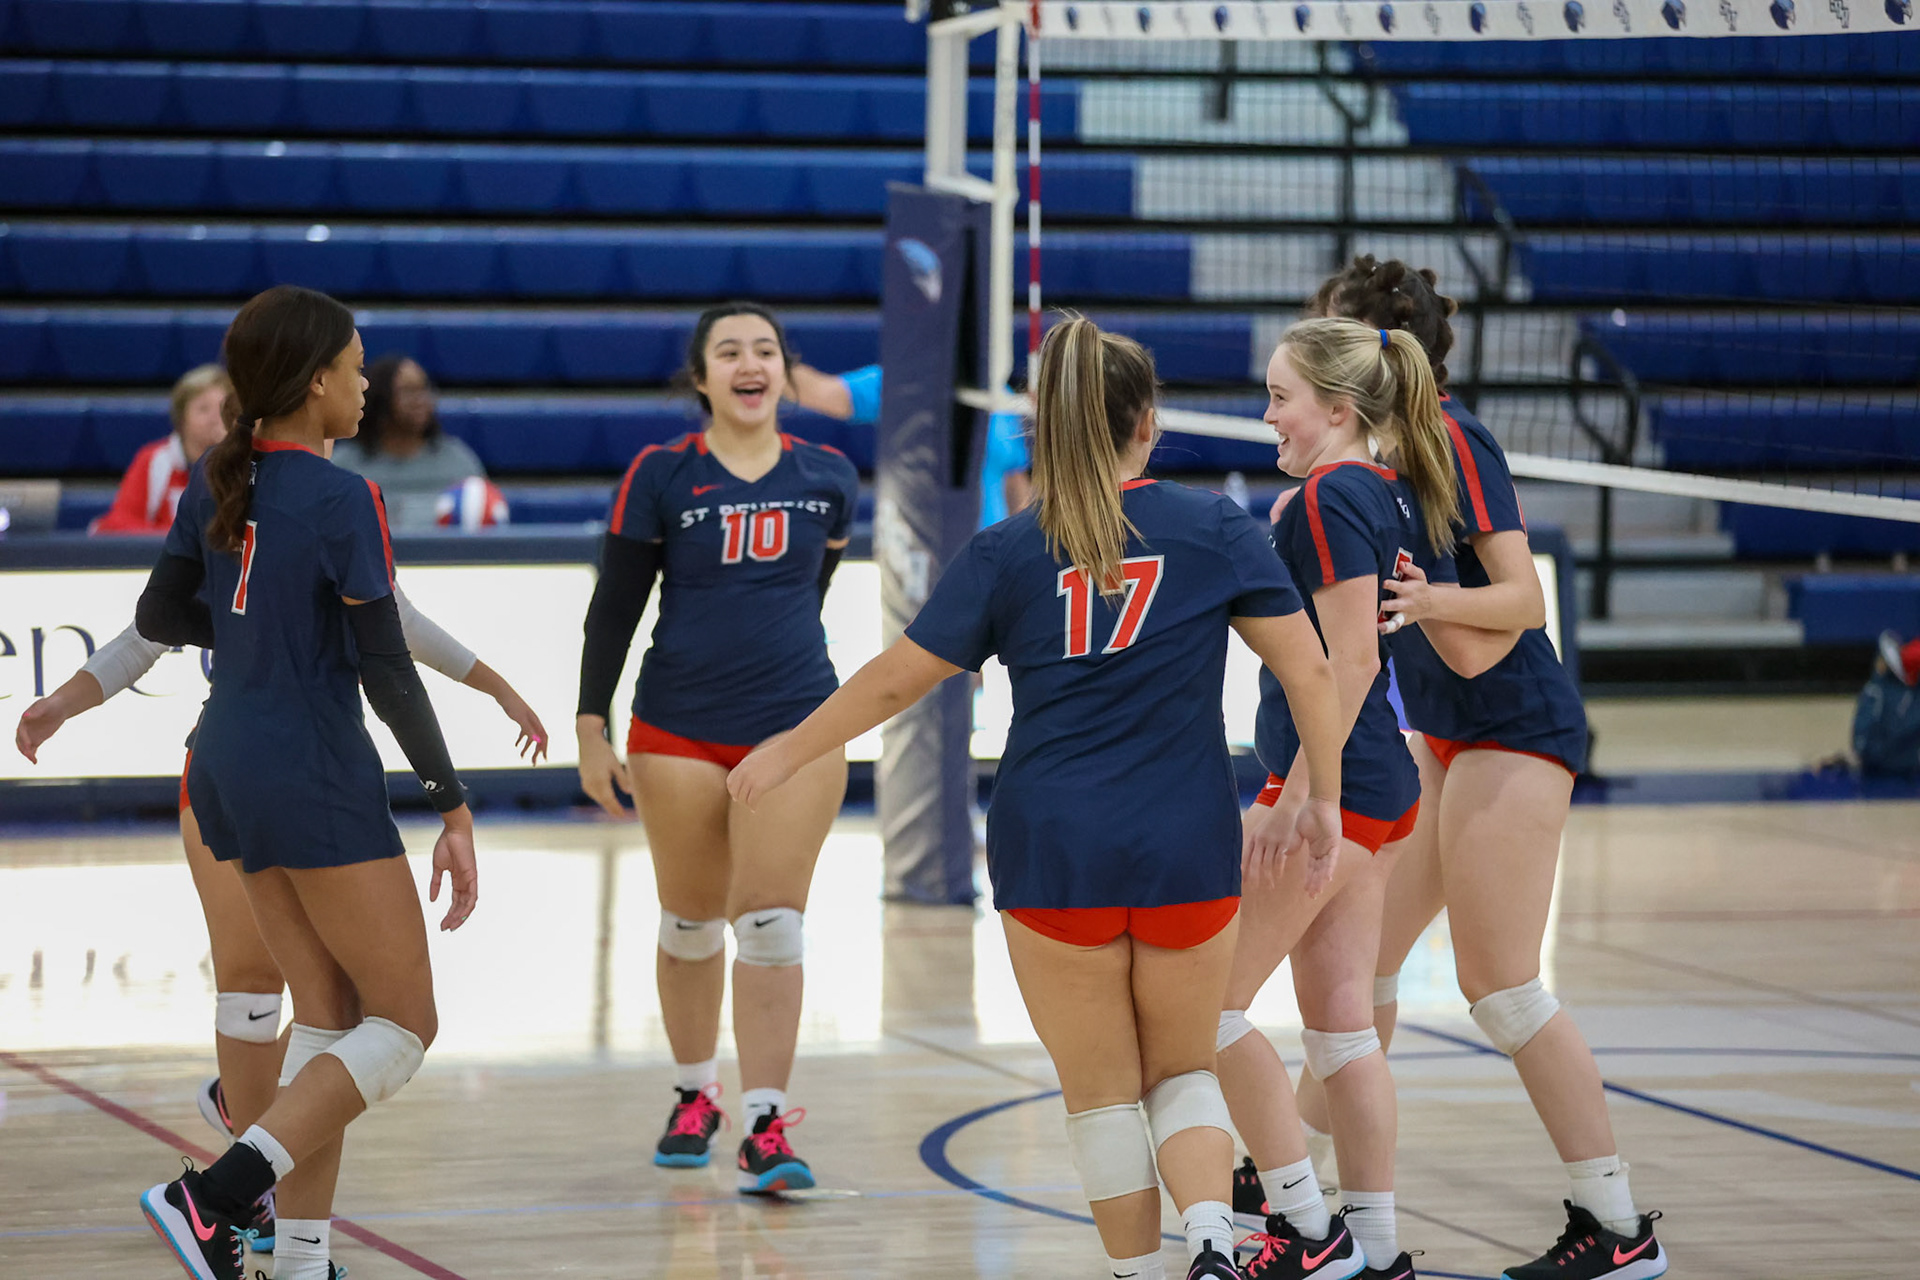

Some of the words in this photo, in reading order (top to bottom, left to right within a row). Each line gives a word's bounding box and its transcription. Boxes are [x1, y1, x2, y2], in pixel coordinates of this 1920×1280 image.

[680, 507, 710, 529] ST
[721, 509, 789, 565] 10
[1056, 554, 1165, 660] 17
